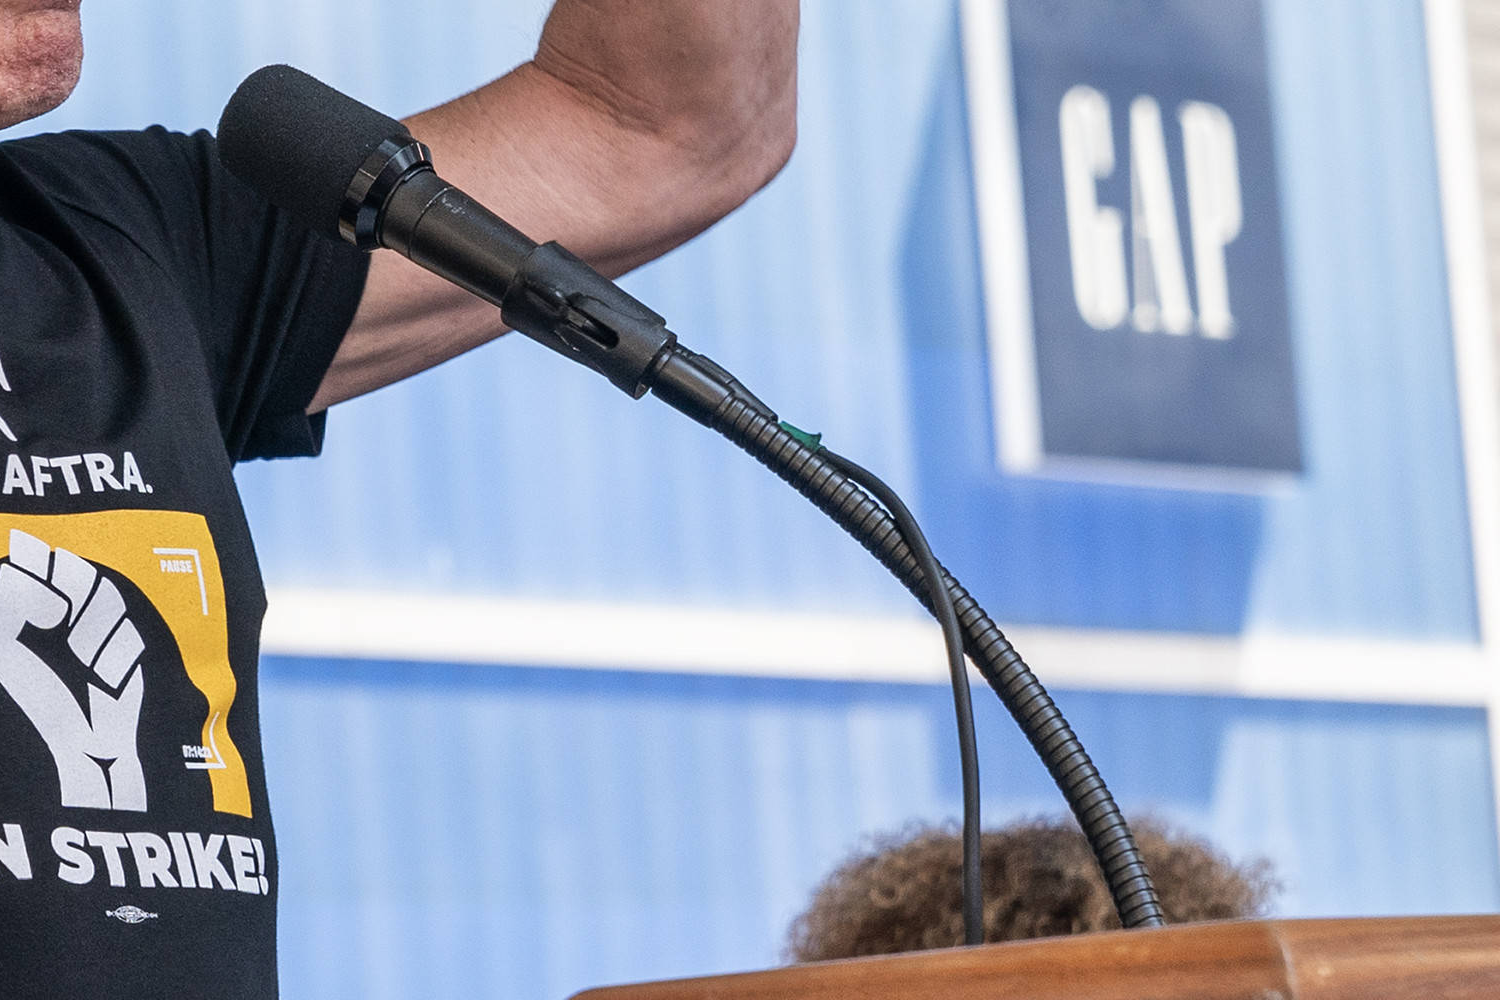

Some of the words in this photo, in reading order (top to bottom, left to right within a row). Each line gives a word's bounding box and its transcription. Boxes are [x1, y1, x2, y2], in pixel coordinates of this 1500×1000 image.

[1059, 85, 1243, 340] GAP
[160, 559, 193, 573] PAUSE
[50, 827, 269, 895] STRIKE!
